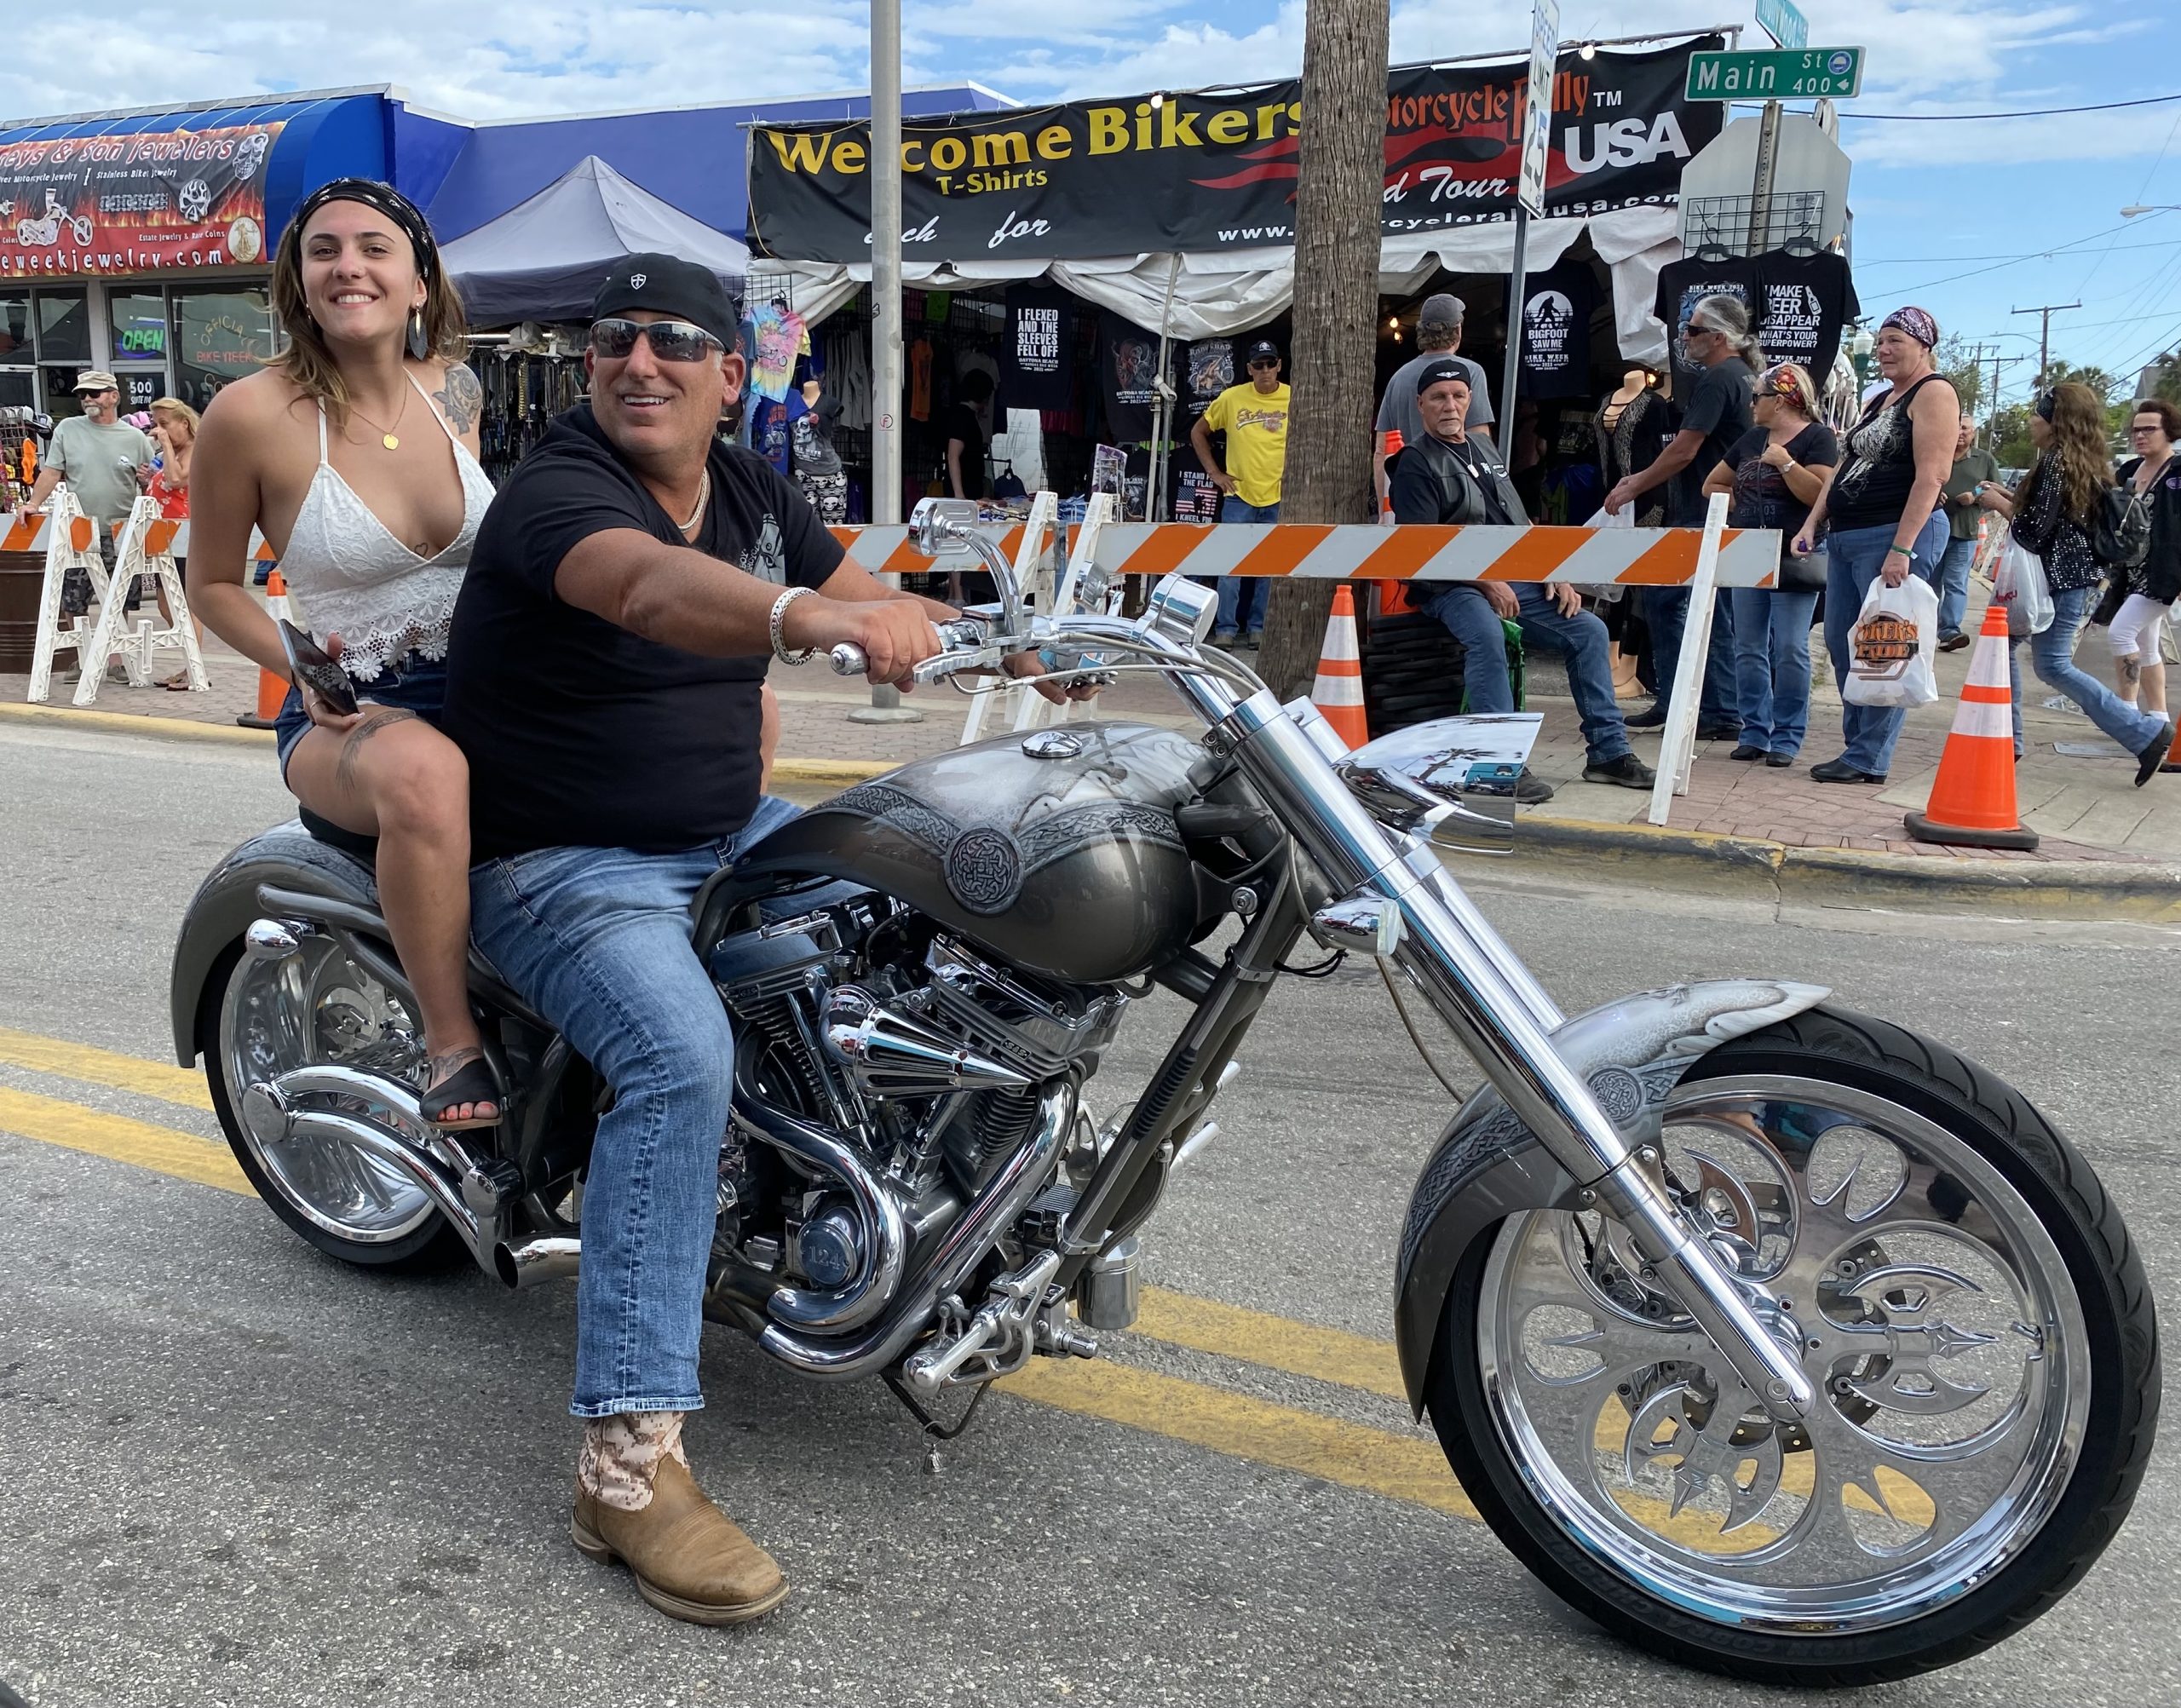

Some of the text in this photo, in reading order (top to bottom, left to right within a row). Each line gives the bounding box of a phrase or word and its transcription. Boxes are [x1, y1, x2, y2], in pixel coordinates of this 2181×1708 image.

[1697, 53, 1821, 90] Main St
[1793, 78, 1830, 94] 400
[1388, 72, 1622, 140] torcycle Rlly TM
[767, 124, 1073, 175] Wecome
[1524, 100, 1547, 188] 25
[1565, 111, 1691, 174] USA
[51, 141, 73, 164] &
[14, 173, 50, 183] Motorcycle
[51, 171, 78, 182] Jewelry
[96, 170, 128, 179] Stainless
[935, 170, 1048, 195] T-Shirts
[1420, 167, 1509, 203] Tour
[864, 210, 1050, 249] ech for
[1770, 285, 1804, 297] MAKE
[1017, 308, 1059, 322] I FLEXED
[1017, 320, 1059, 334] AND THE
[1528, 328, 1569, 340] BIGFOOT
[122, 329, 164, 351] OPEN
[1017, 332, 1058, 346] SLEEVES
[1758, 330, 1818, 341] WHAT'S YOUR
[1532, 338, 1563, 348] SAW ME
[1758, 338, 1818, 348] SUPERPOWER?
[197, 350, 221, 363] BIKE
[1016, 344, 1059, 358] FELL OFF
[129, 381, 152, 394] 500
[1179, 470, 1183, 479] I
[1183, 471, 1206, 480] STAND
[1183, 478, 1214, 488] THE FLAG
[1179, 514, 1200, 523] KNEEL
[1859, 619, 1918, 641] IKER'S
[809, 1246, 841, 1270] 124
